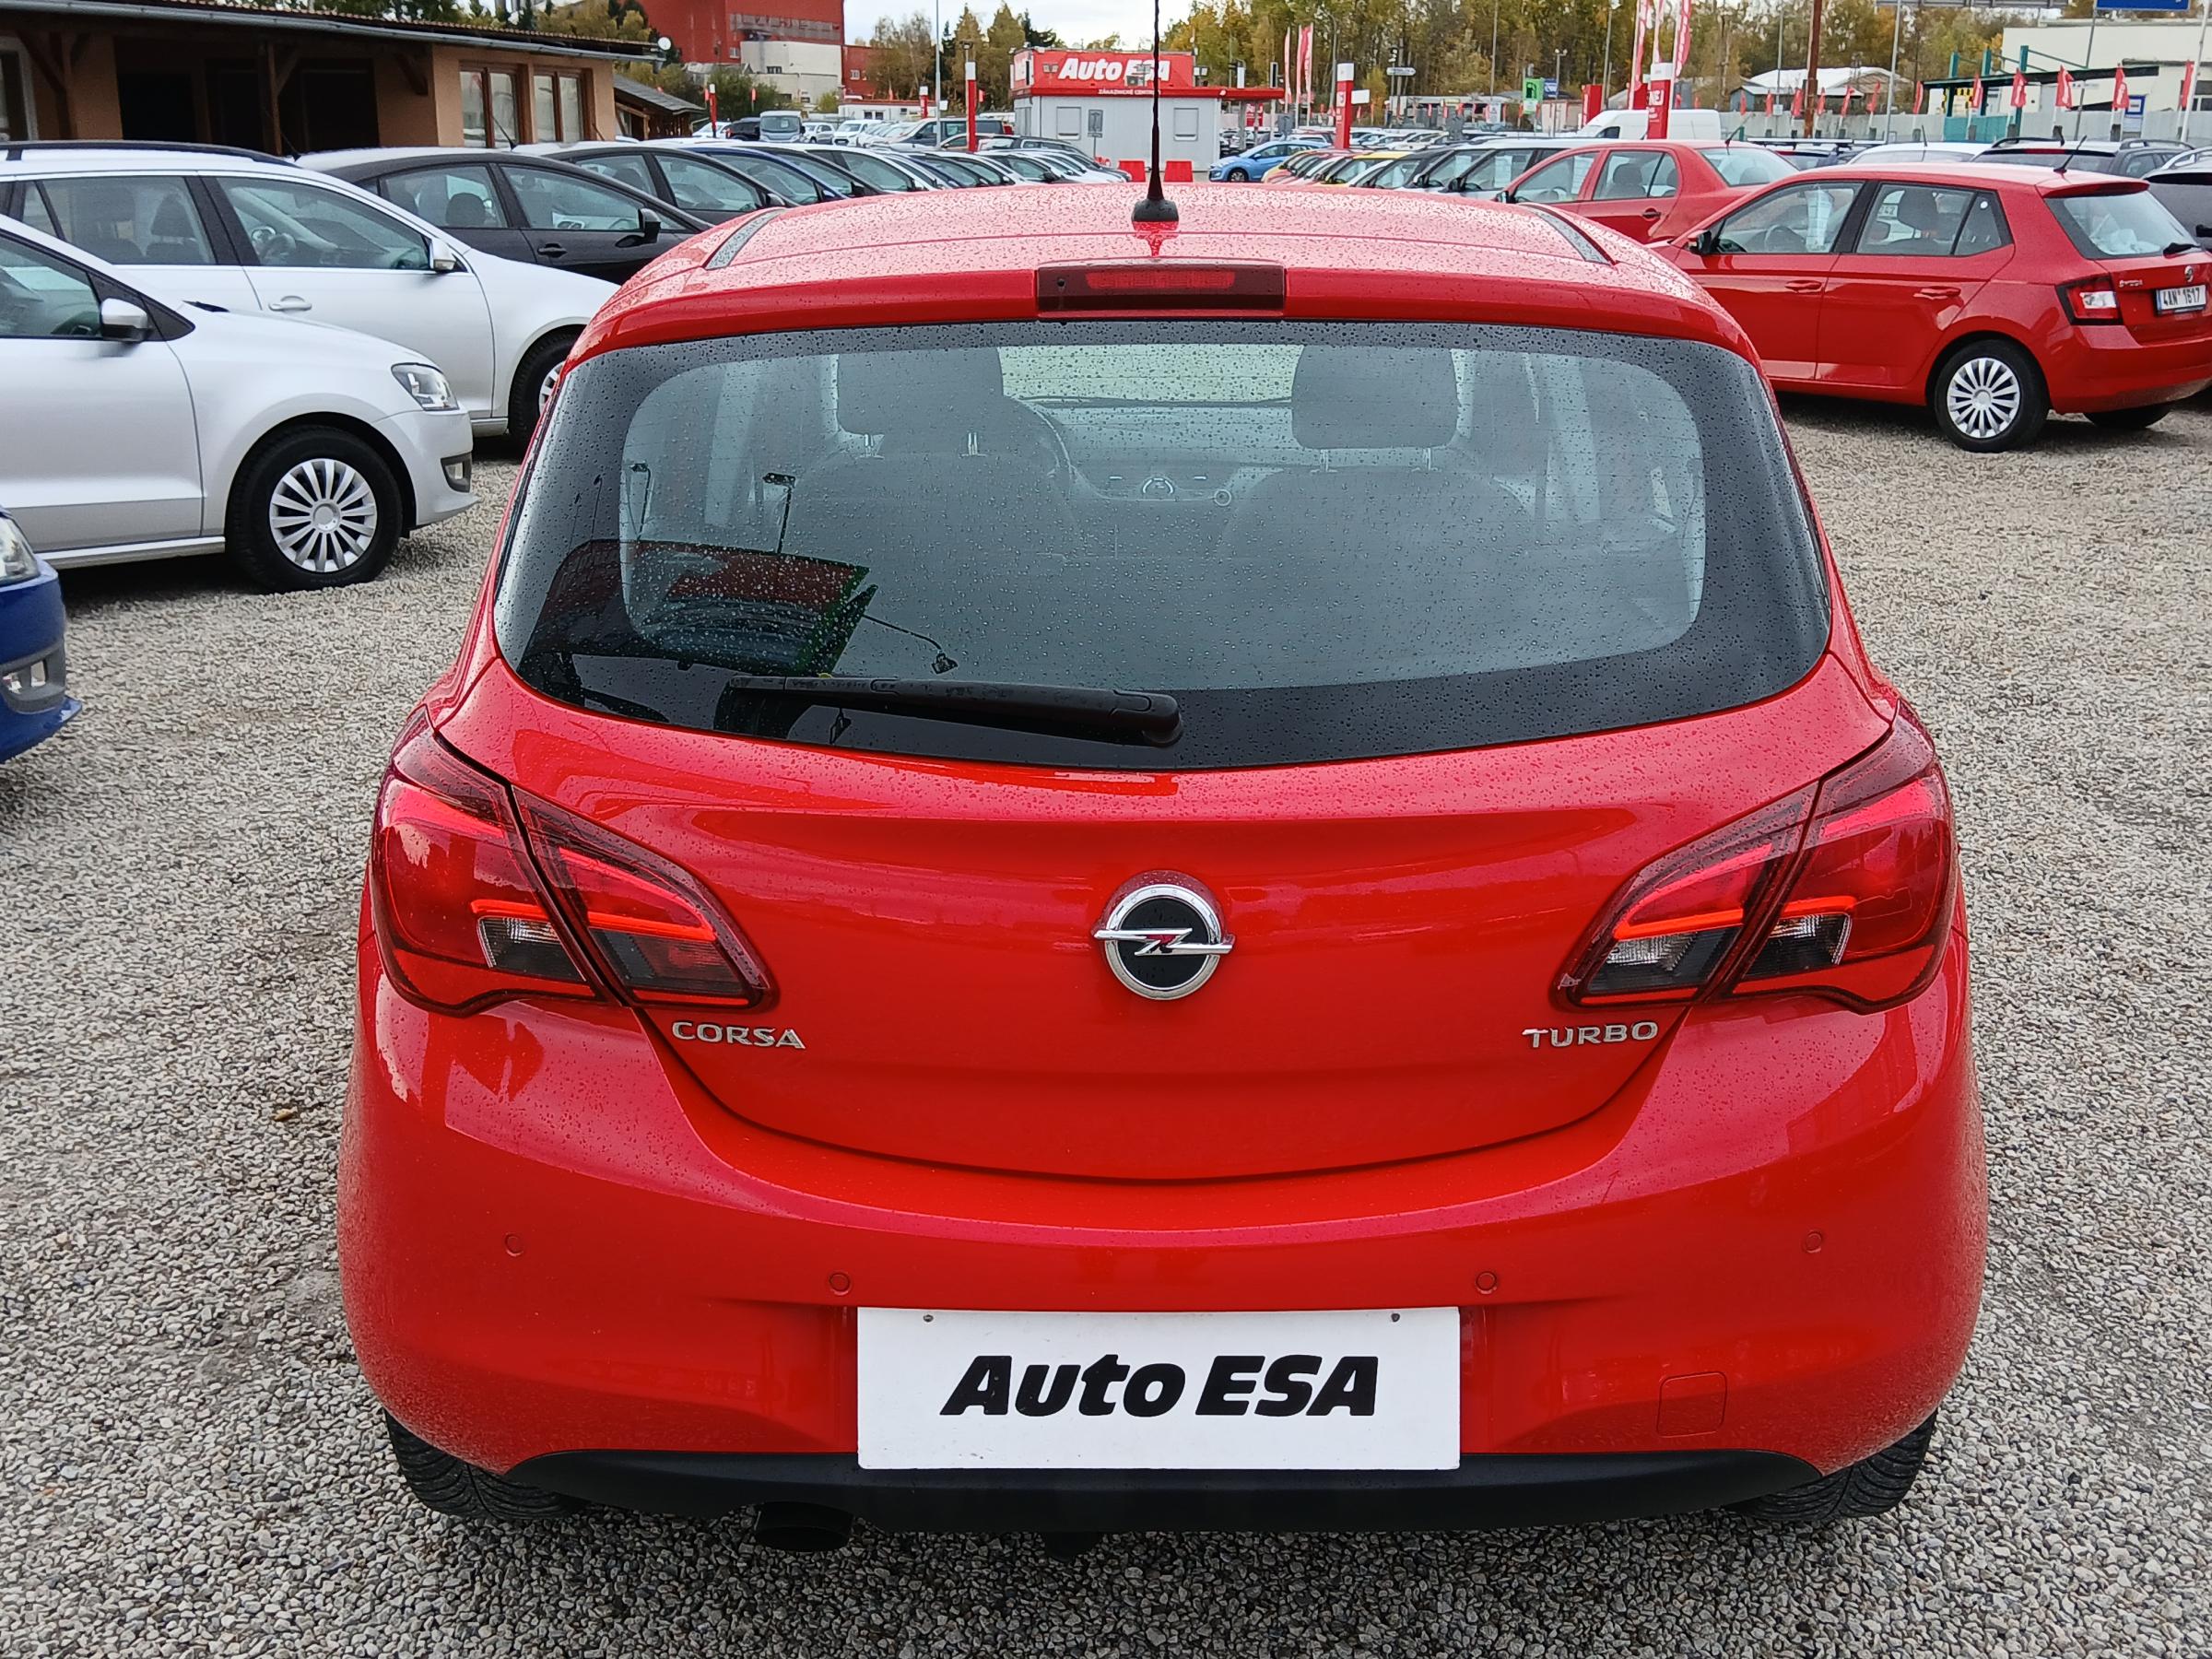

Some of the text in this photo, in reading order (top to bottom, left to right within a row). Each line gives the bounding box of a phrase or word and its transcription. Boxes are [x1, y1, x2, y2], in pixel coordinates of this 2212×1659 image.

[1058, 58, 1123, 81] Auto
[672, 1021, 806, 1049] CORSA
[1522, 1021, 1658, 1048] TURBO
[939, 1354, 1379, 1417] Auto ESA
